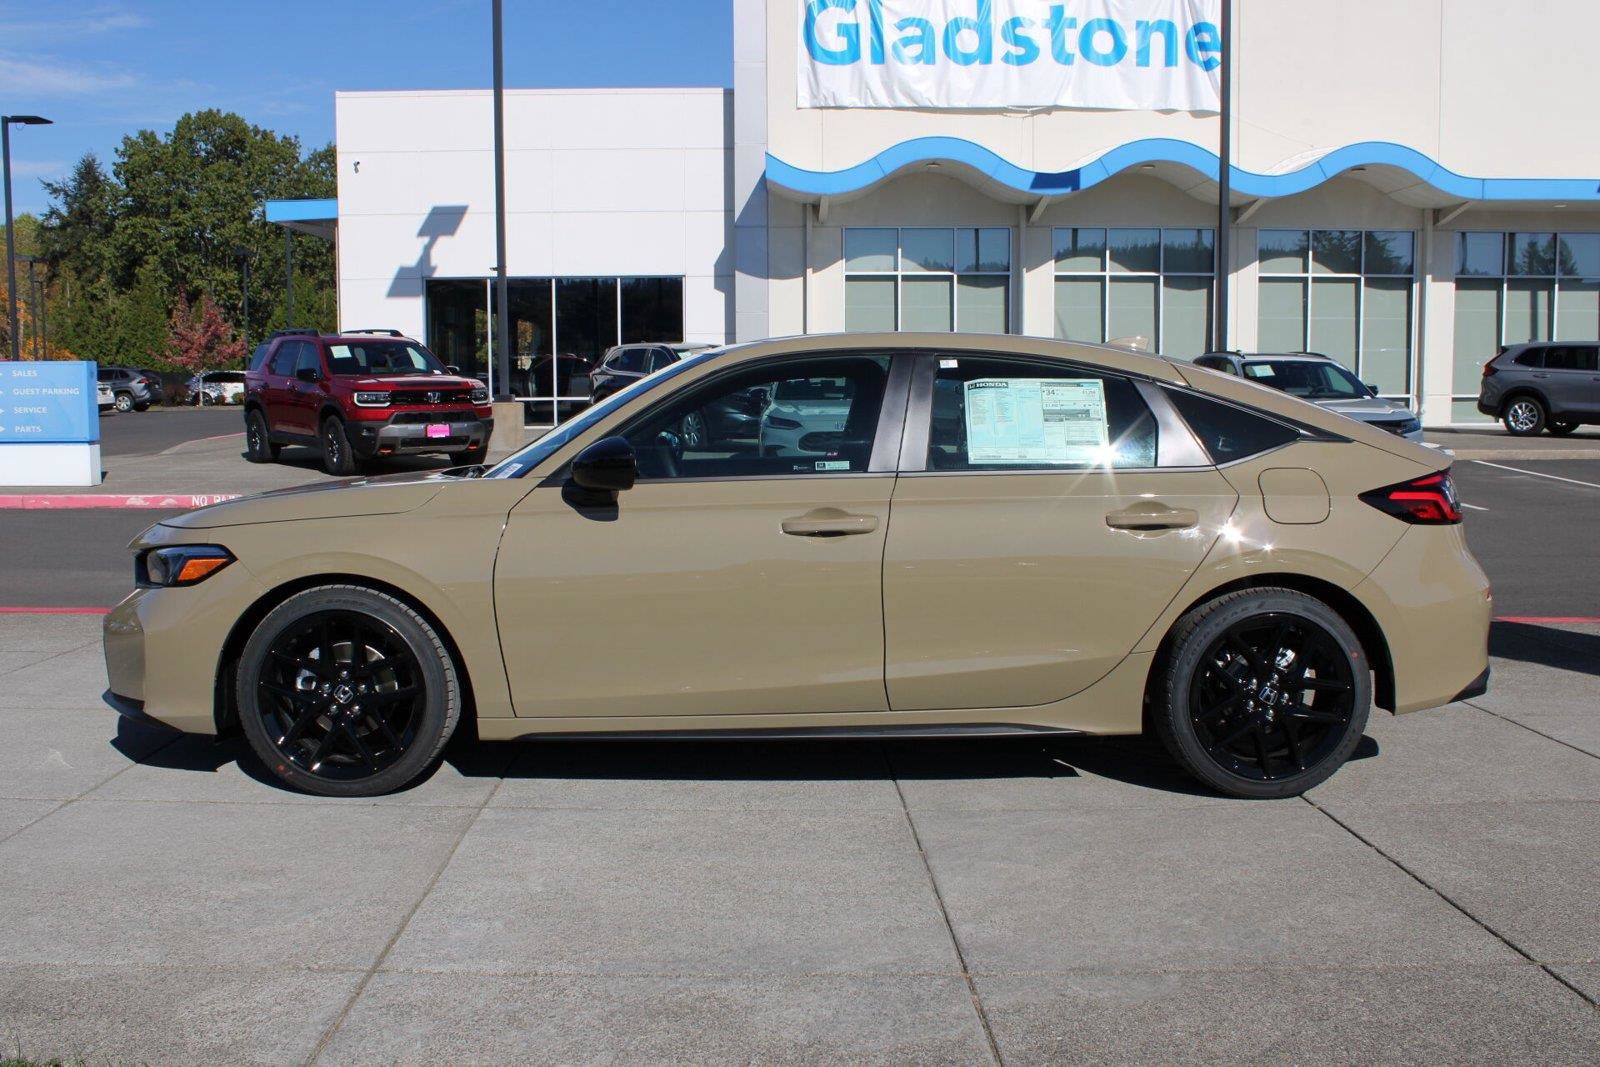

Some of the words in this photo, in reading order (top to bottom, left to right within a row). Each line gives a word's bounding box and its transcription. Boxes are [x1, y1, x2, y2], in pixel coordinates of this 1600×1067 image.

[803, 0, 1222, 72] Gladstone
[12, 369, 38, 377] SALES
[13, 387, 40, 395] GUEST
[42, 387, 80, 395] PARKING
[14, 406, 49, 414] SERVICE
[15, 425, 42, 433] PARTS
[191, 495, 208, 506] NO
